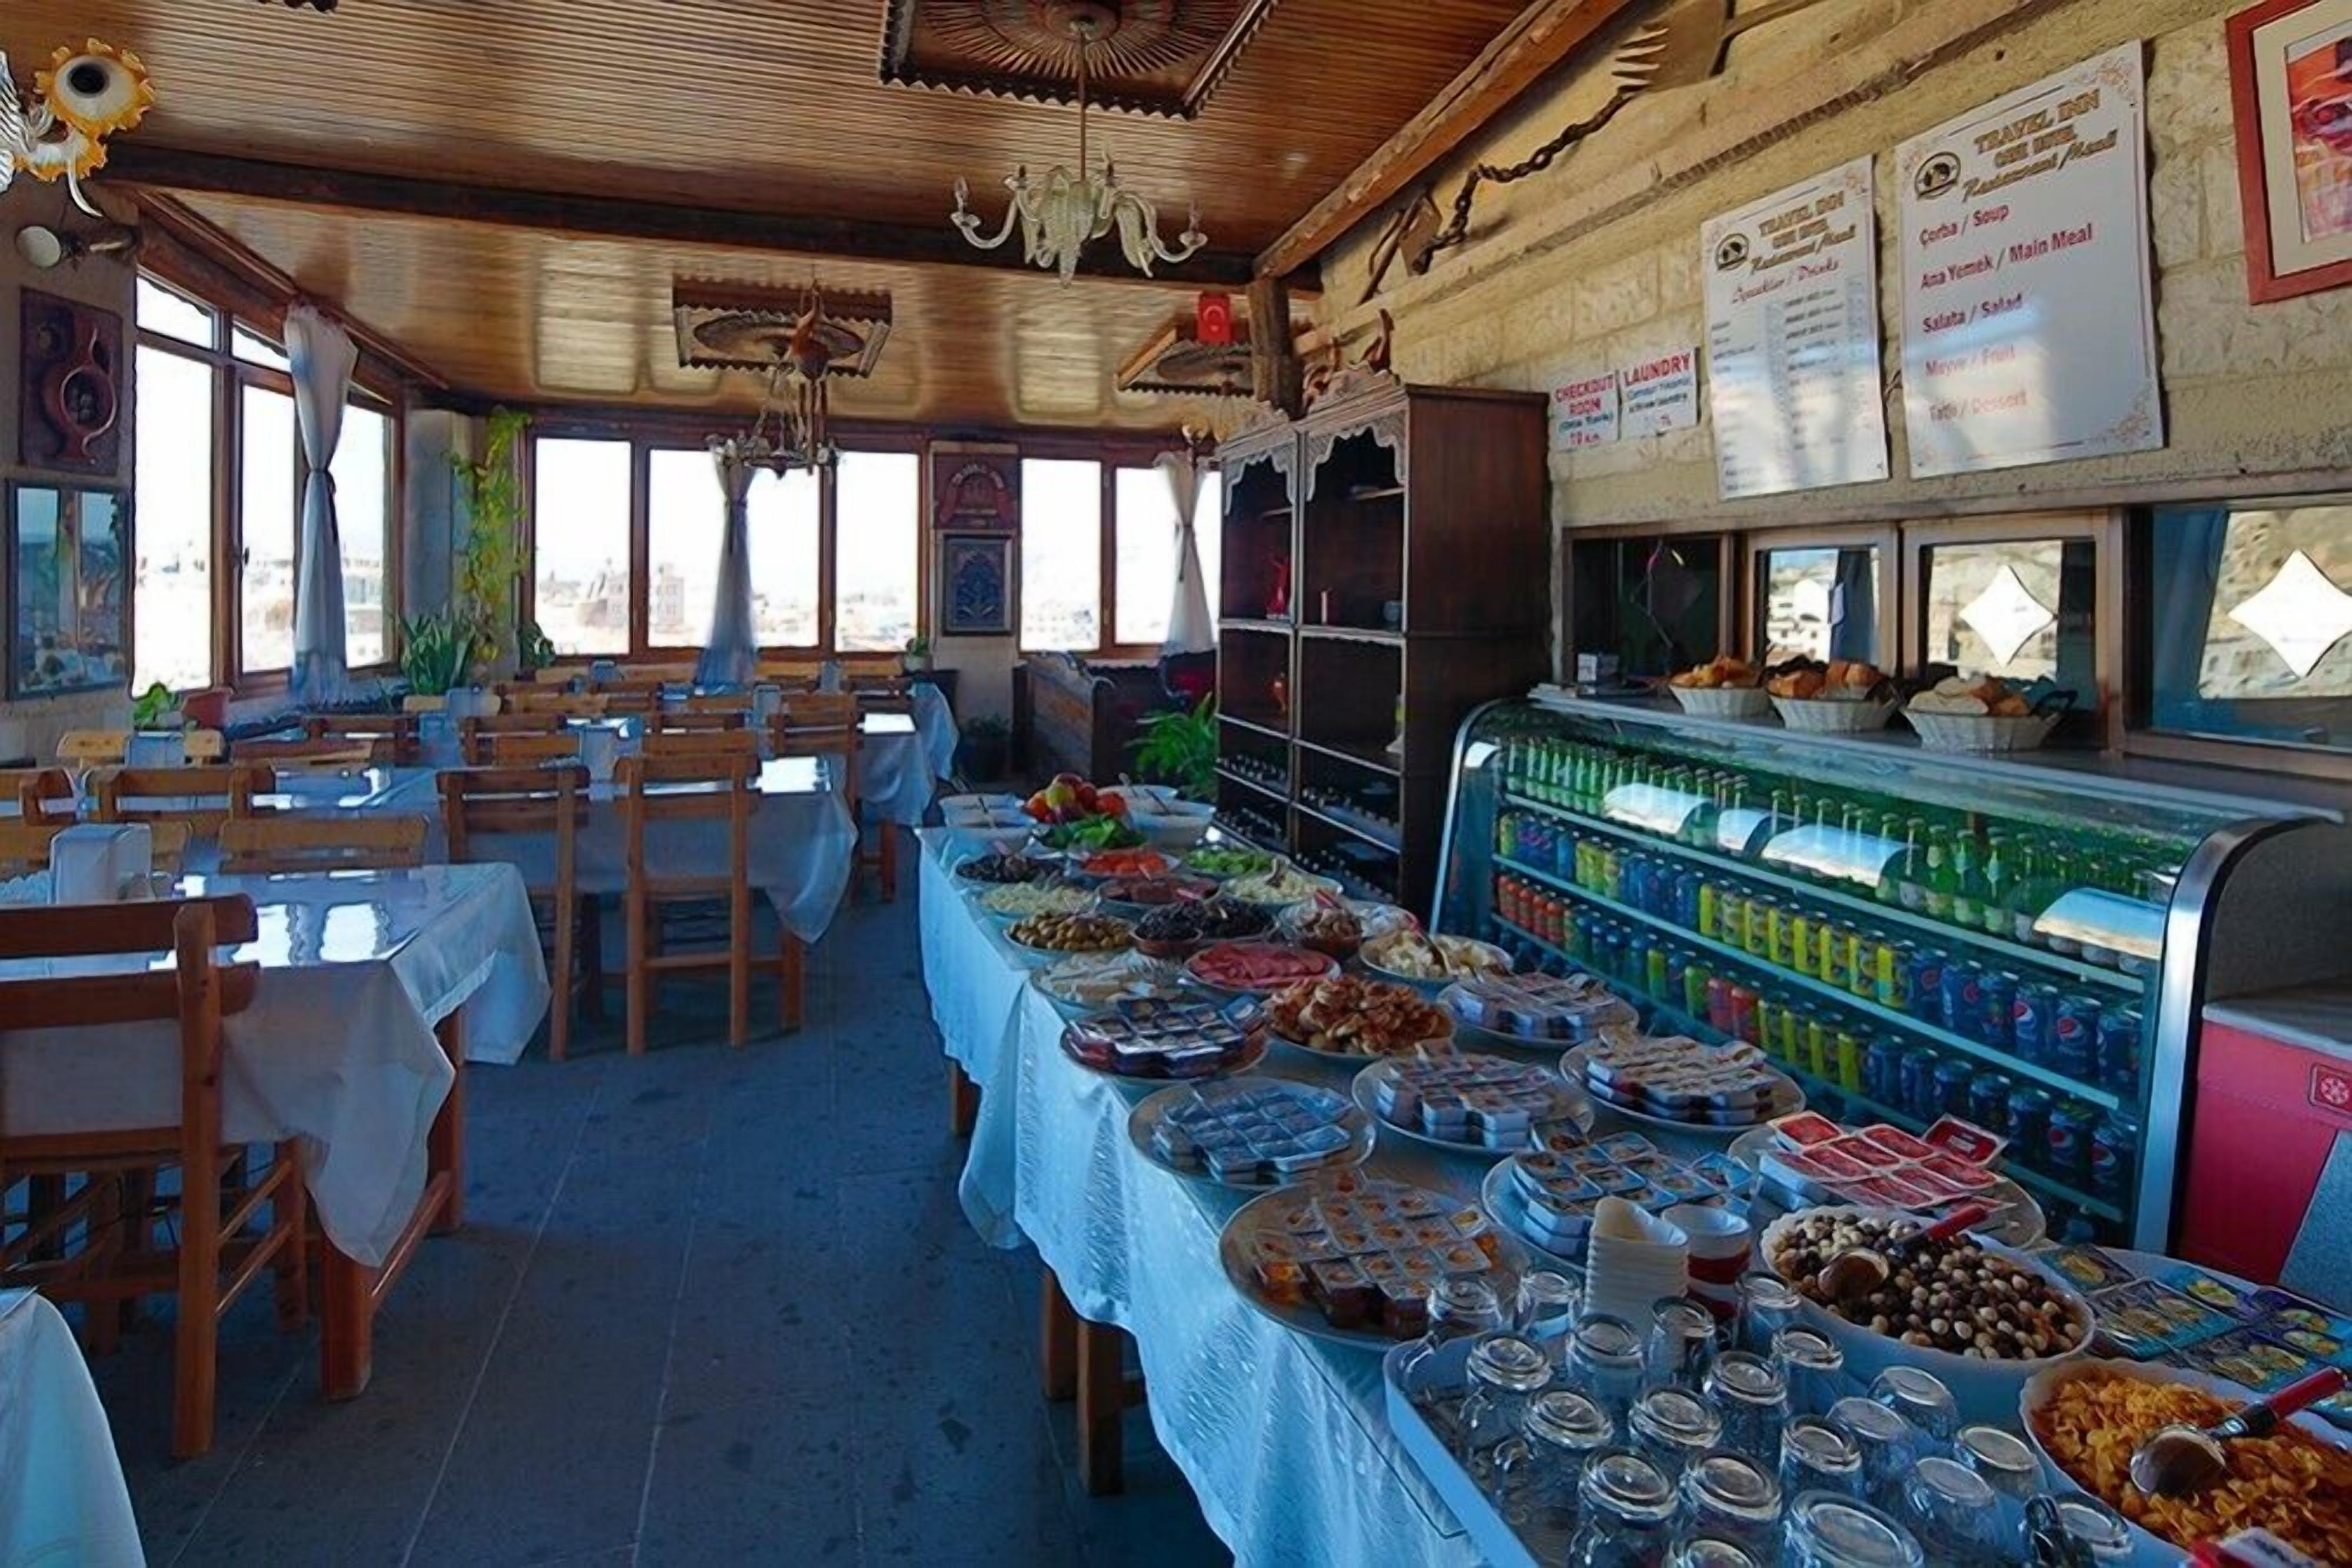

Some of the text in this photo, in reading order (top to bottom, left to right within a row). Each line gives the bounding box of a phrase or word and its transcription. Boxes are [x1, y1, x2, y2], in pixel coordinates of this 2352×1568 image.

[1974, 108, 2054, 155] TRAVEL
[2058, 88, 2099, 122] INN
[1973, 205, 2009, 226] Soup
[1922, 271, 1945, 289] Ana
[1948, 255, 1994, 280] Yemek
[2009, 240, 2049, 261] Main
[2051, 222, 2092, 250] Meal
[1923, 311, 1966, 333] Salata
[1982, 293, 2022, 317] Salad
[1624, 353, 1690, 386] LAUNDRY
[1554, 374, 1613, 403] CHECKOUT
